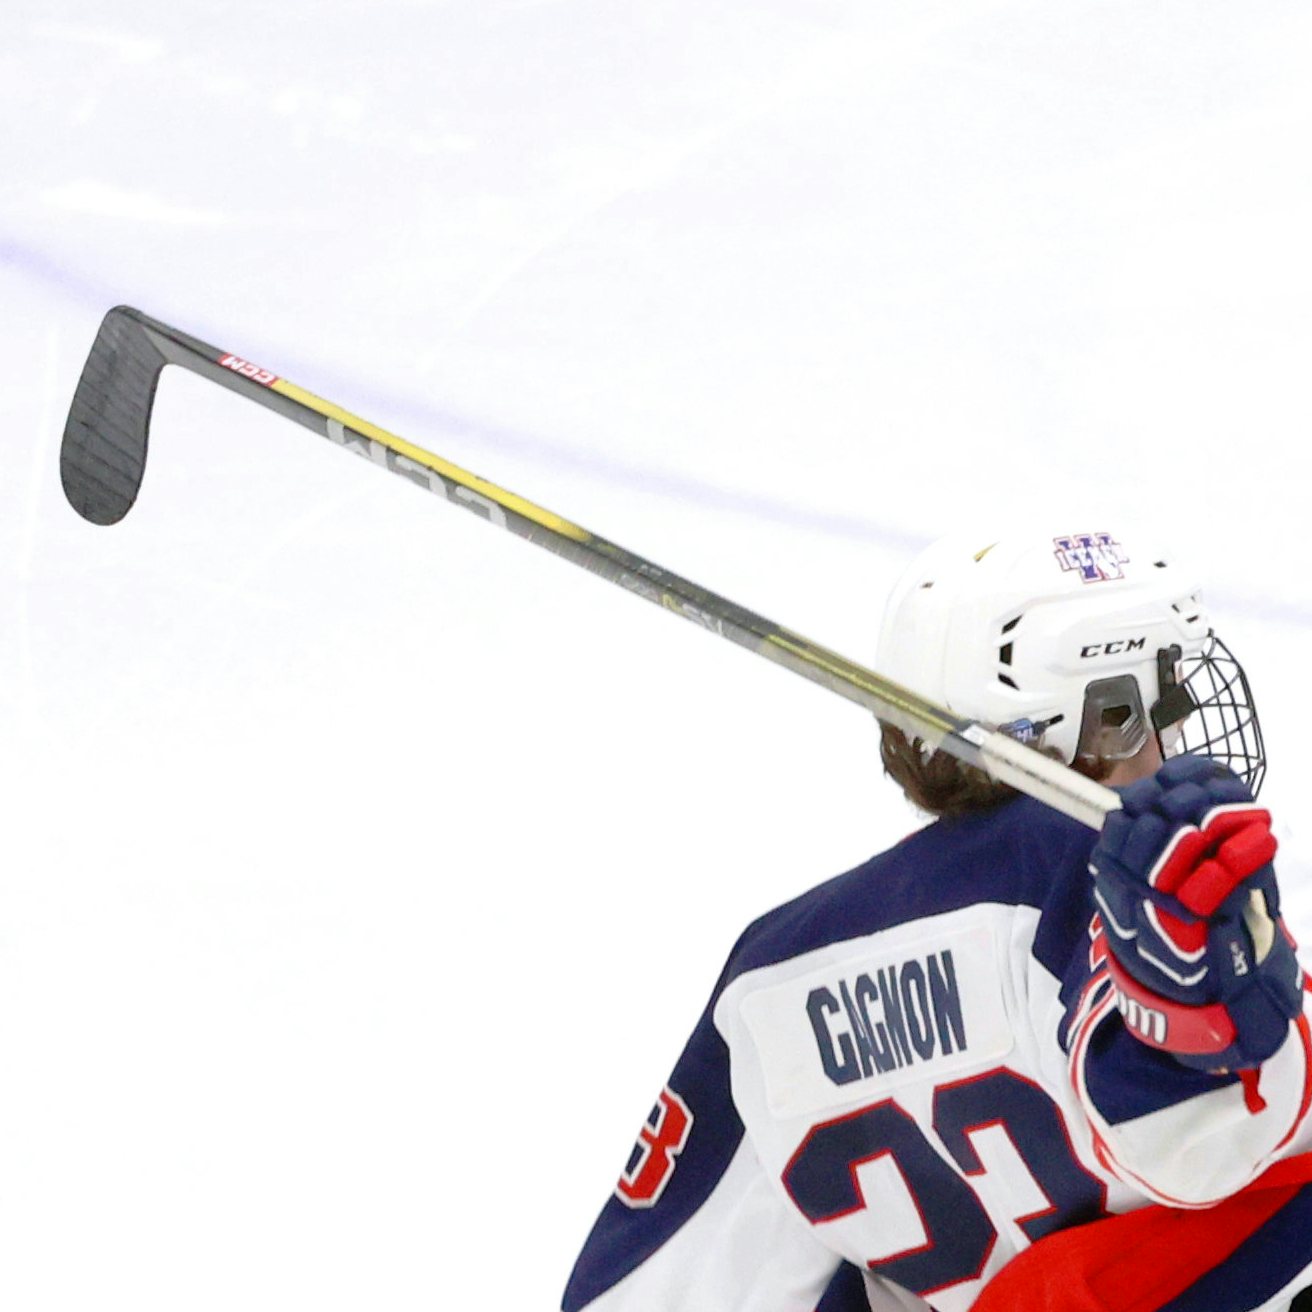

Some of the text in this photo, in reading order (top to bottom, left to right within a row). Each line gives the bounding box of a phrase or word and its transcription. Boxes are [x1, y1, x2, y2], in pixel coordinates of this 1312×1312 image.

[221, 354, 276, 386] CCM
[1080, 636, 1147, 659] CCM
[805, 949, 968, 1087] GAGNON
